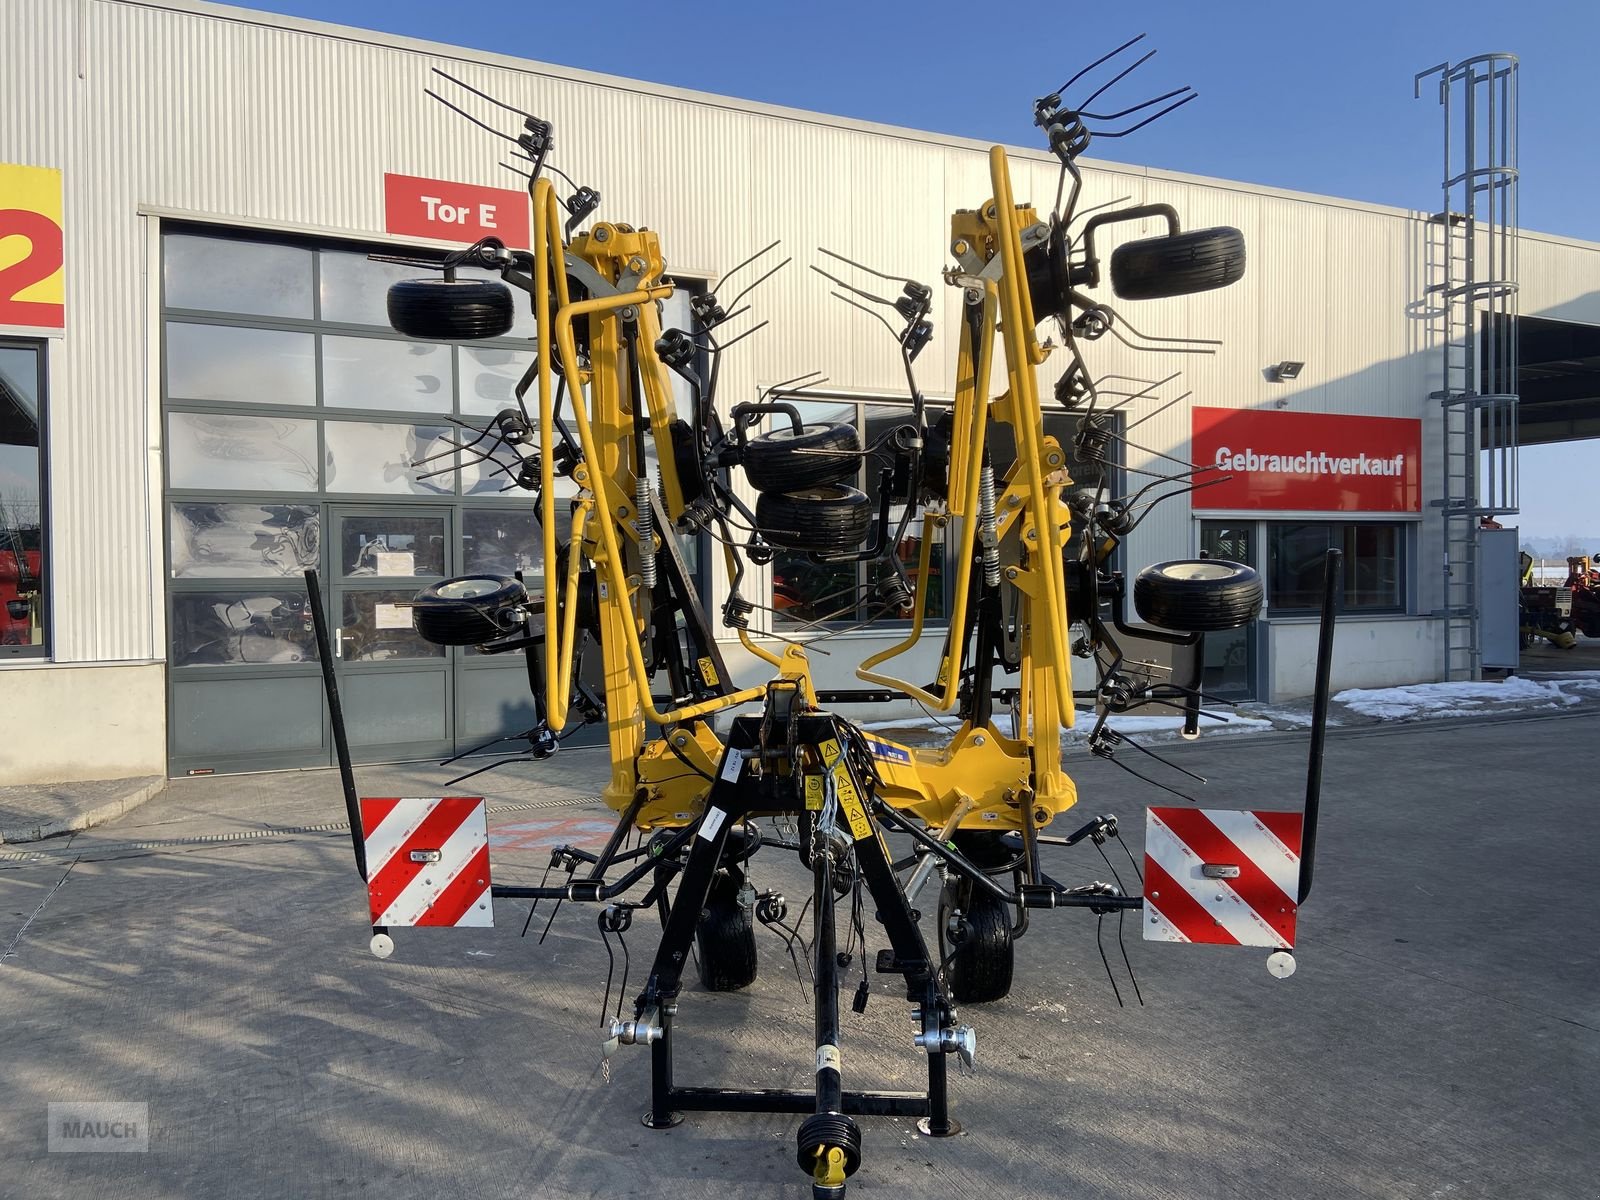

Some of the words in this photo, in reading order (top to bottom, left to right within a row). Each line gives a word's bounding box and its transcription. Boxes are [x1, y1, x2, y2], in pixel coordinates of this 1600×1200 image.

[421, 196, 470, 225] Tor
[479, 203, 498, 229] E
[1215, 446, 1404, 477] Gebrauchtverkauf
